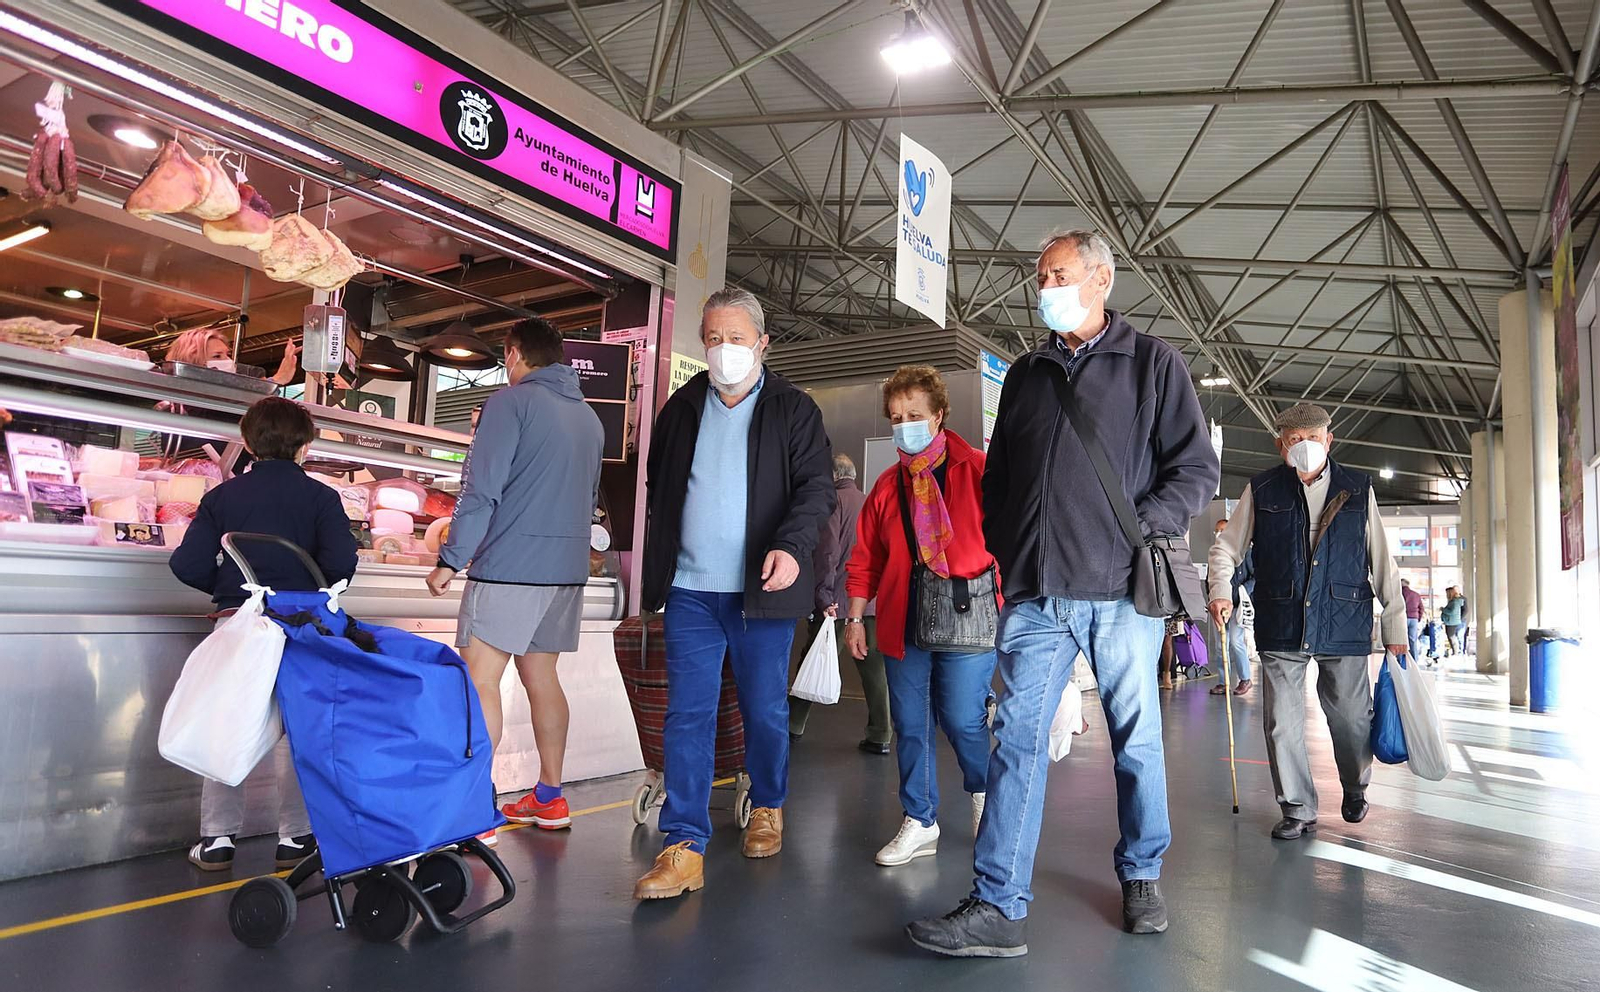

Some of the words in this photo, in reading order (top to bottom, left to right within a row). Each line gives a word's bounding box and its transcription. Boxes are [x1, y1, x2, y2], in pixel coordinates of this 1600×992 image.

[225, 0, 354, 64] ERO
[513, 126, 611, 186] Ayuntamiento
[540, 159, 559, 178] de
[563, 167, 610, 203] Huelva
[902, 213, 933, 248] HUELVA
[674, 369, 682, 381] LA
[356, 438, 384, 449] Natural
